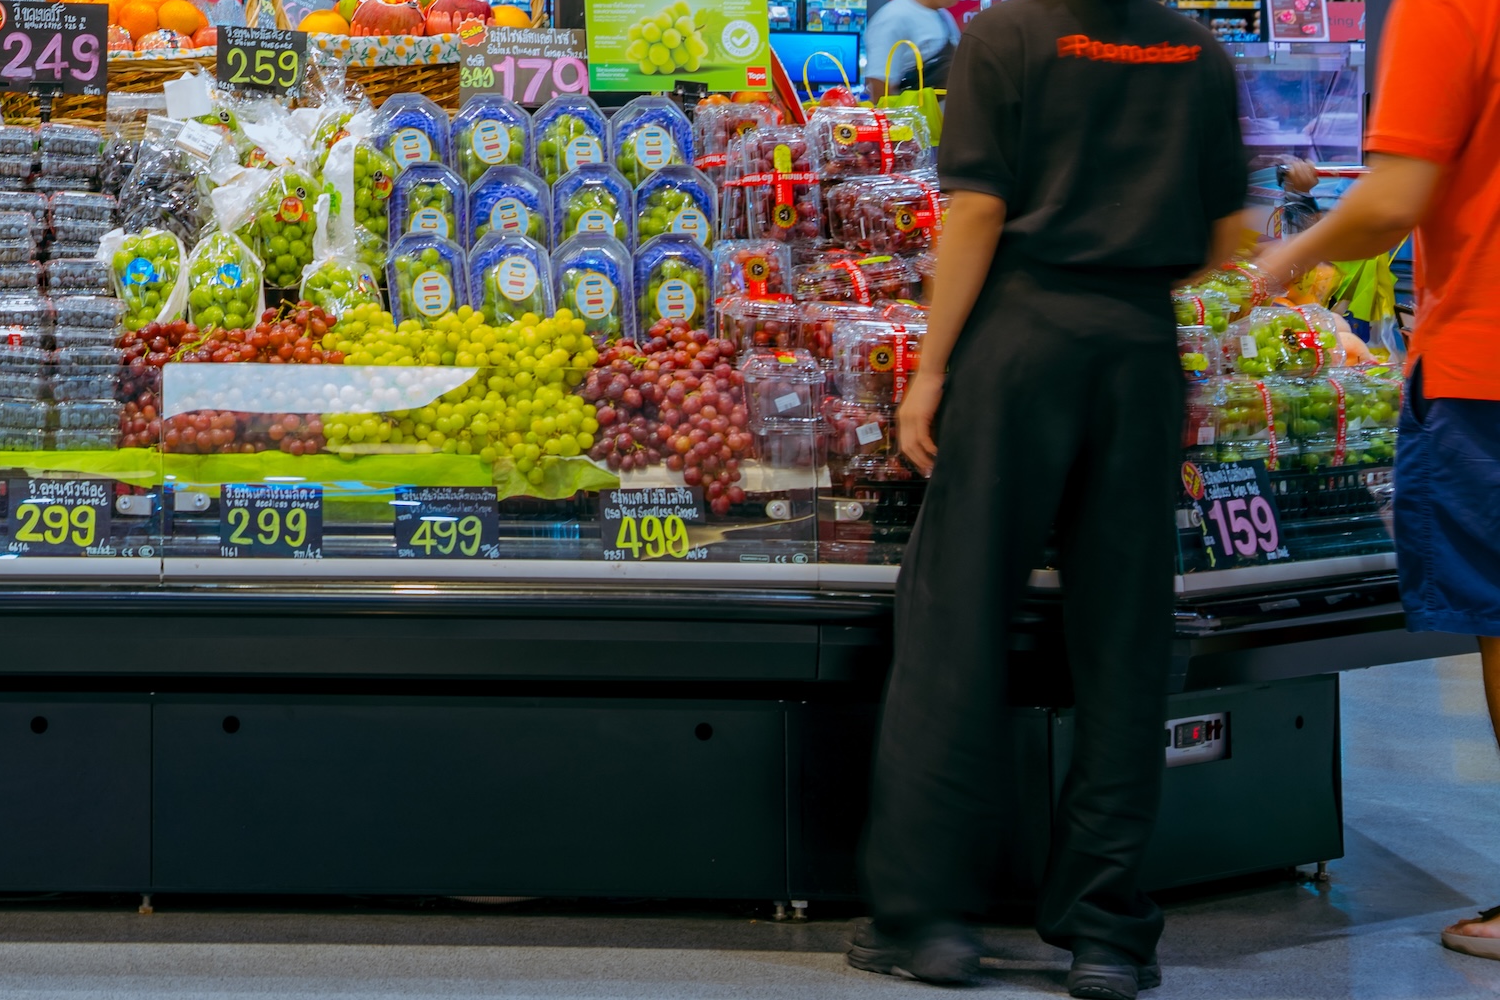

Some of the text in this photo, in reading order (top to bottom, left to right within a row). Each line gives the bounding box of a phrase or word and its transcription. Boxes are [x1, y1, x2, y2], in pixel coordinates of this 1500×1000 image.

[461, 25, 484, 39] Sale
[1, 32, 99, 81] 249
[227, 48, 299, 87] 259
[747, 71, 766, 81] Tops
[492, 56, 589, 104] 179
[15, 503, 96, 547] 299
[227, 507, 307, 547] 299
[409, 515, 482, 556] 499
[616, 515, 690, 558] 499
[1208, 496, 1279, 556] 159
